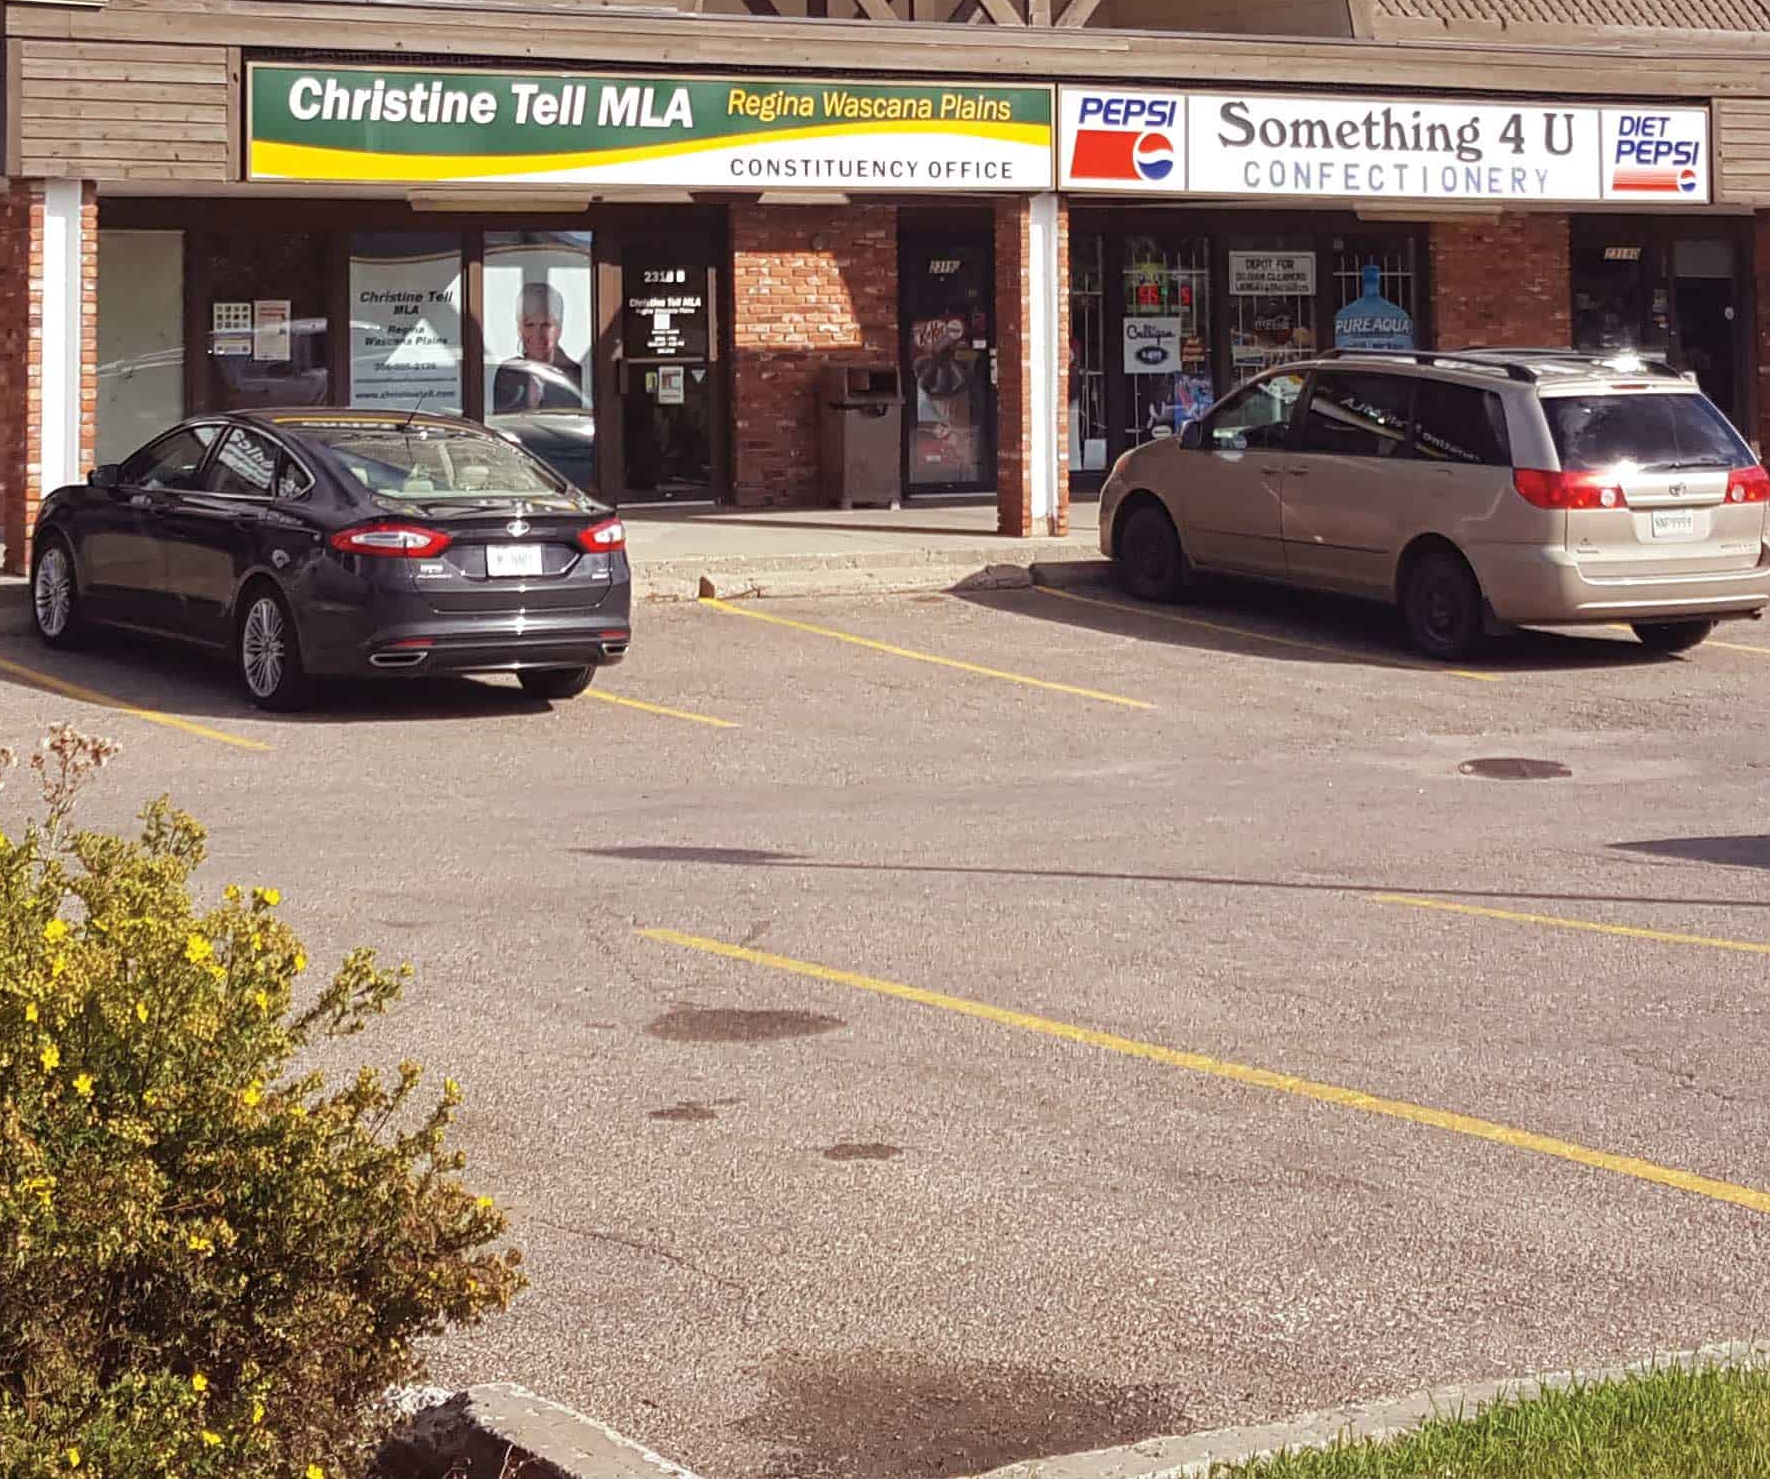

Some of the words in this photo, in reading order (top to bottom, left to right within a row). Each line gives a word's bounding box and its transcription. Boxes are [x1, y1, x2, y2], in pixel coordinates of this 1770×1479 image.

[289, 78, 497, 124] Christine
[512, 84, 586, 125] Tell
[598, 87, 693, 128] MLA
[728, 89, 814, 121] Regina
[823, 91, 932, 119] Wascana
[941, 94, 1012, 120] Plains
[1079, 97, 1176, 127] PEPSI
[1218, 101, 1483, 163] Something
[1499, 113, 1525, 154] 4
[1544, 113, 1574, 156] U
[1619, 116, 1670, 138] DIET
[1615, 140, 1700, 166] PEPSI
[730, 159, 918, 178] CONSTITUENCY
[929, 161, 1013, 179] OFFICE
[1244, 160, 1548, 194] CONFECTIONERY
[360, 291, 423, 302] Christine
[429, 291, 454, 302] Tell
[393, 305, 419, 314] MLA
